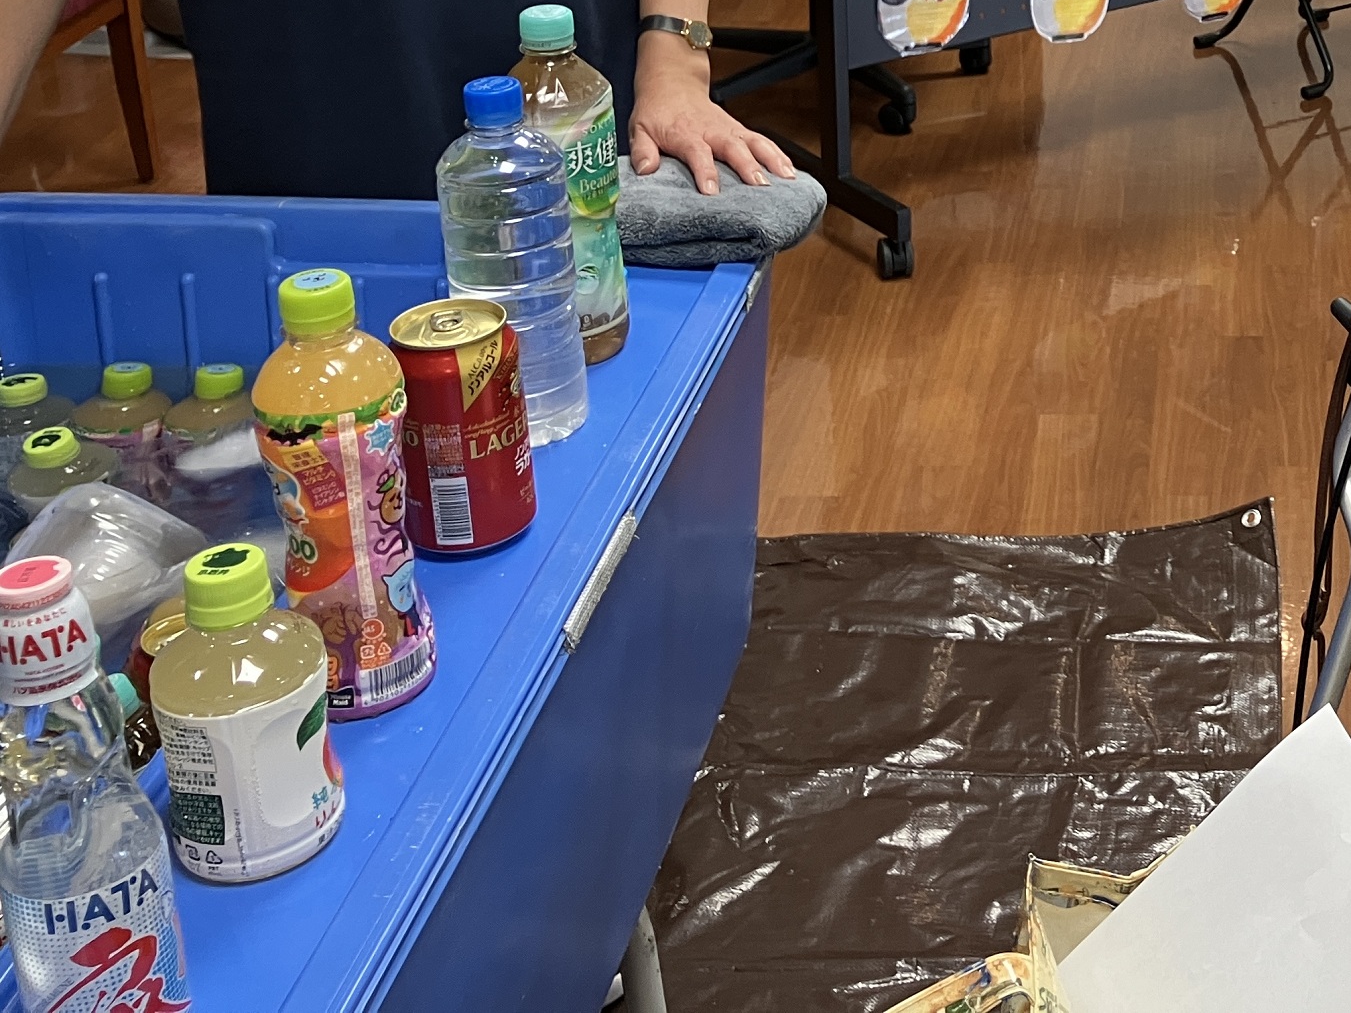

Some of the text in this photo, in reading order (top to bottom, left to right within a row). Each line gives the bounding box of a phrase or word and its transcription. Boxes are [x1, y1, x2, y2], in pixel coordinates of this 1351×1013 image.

[468, 339, 498, 396] ノンアルコール
[0, 618, 87, 666] HATA
[44, 868, 158, 935] HATA
